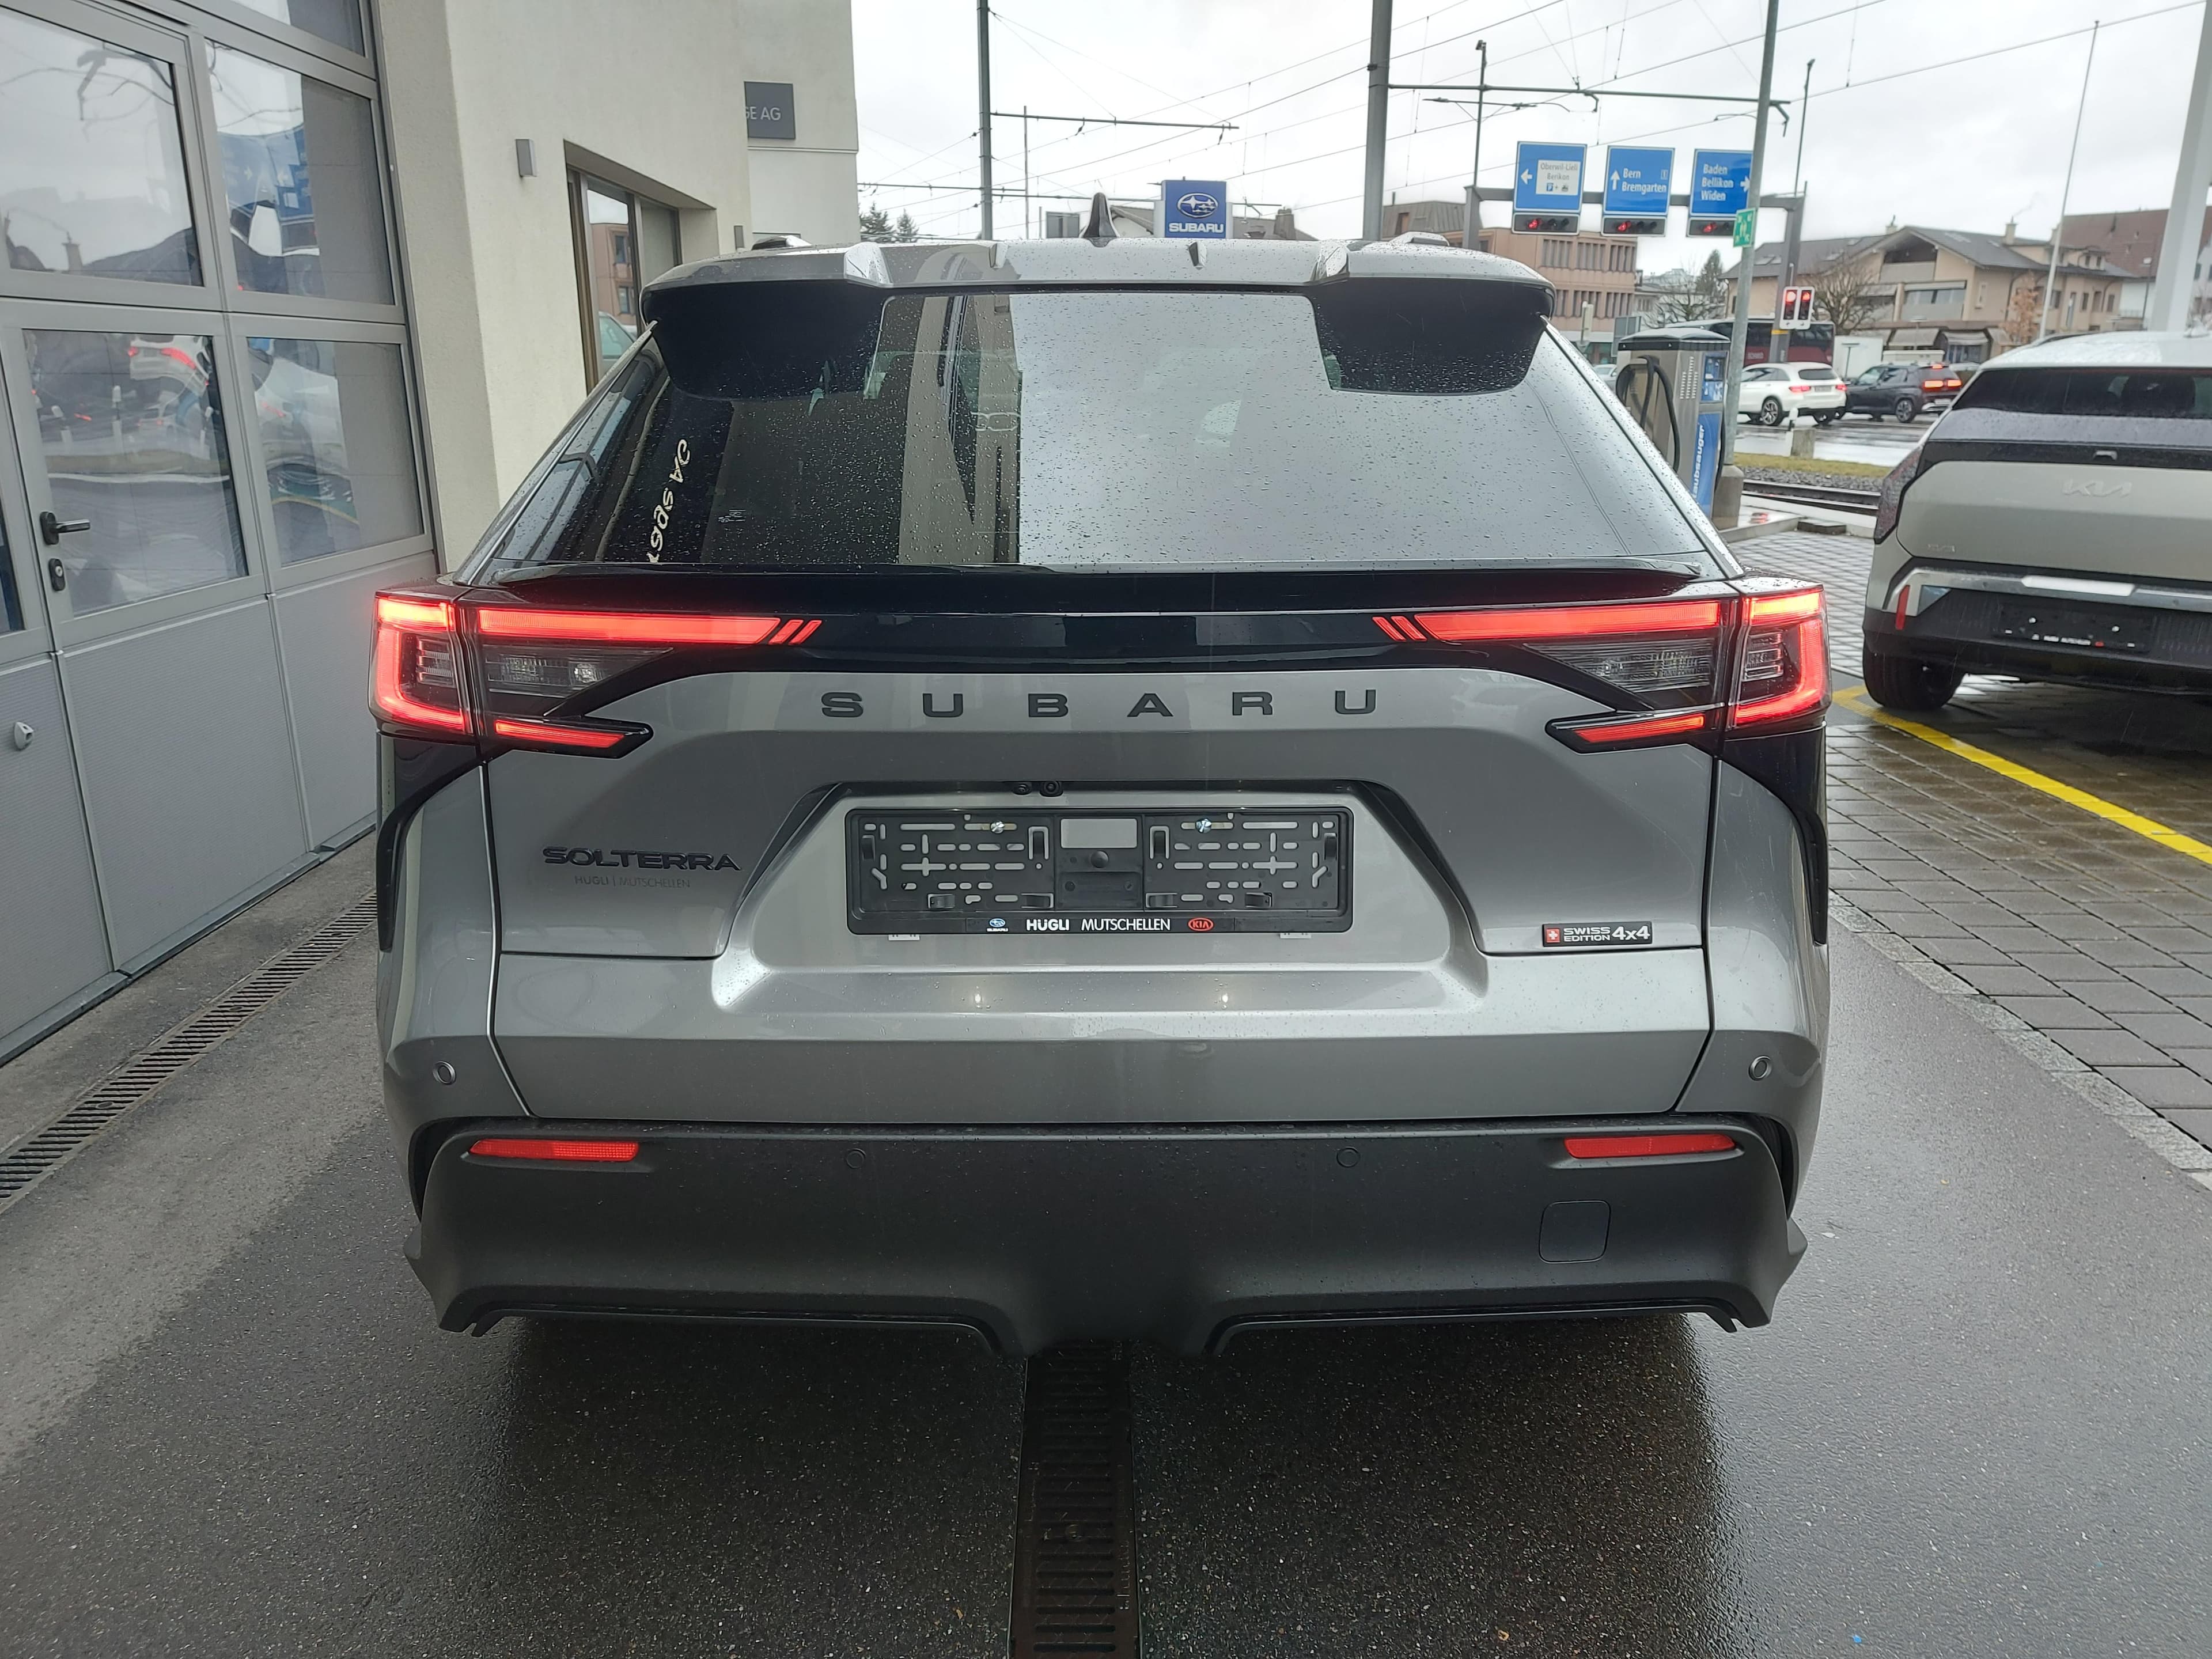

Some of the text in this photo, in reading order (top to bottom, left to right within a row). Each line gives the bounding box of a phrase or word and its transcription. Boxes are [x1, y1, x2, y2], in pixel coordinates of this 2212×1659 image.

[760, 107, 781, 120] AG
[1623, 168, 1641, 179] Bern
[1703, 164, 1728, 175] Baden
[1622, 181, 1667, 195] Bremgarten
[1702, 177, 1734, 188] Bellikon
[1701, 190, 1726, 201] Widen
[1168, 222, 1224, 233] SUBARU
[820, 690, 1377, 718] SUBARU
[543, 846, 742, 871] SOLTERRA
[1026, 918, 1171, 931] HÜGLI MUTSCHELLEN
[1563, 927, 1611, 935] SWISS
[1612, 925, 1650, 941] 4x4
[1563, 934, 1611, 942] EDITION
